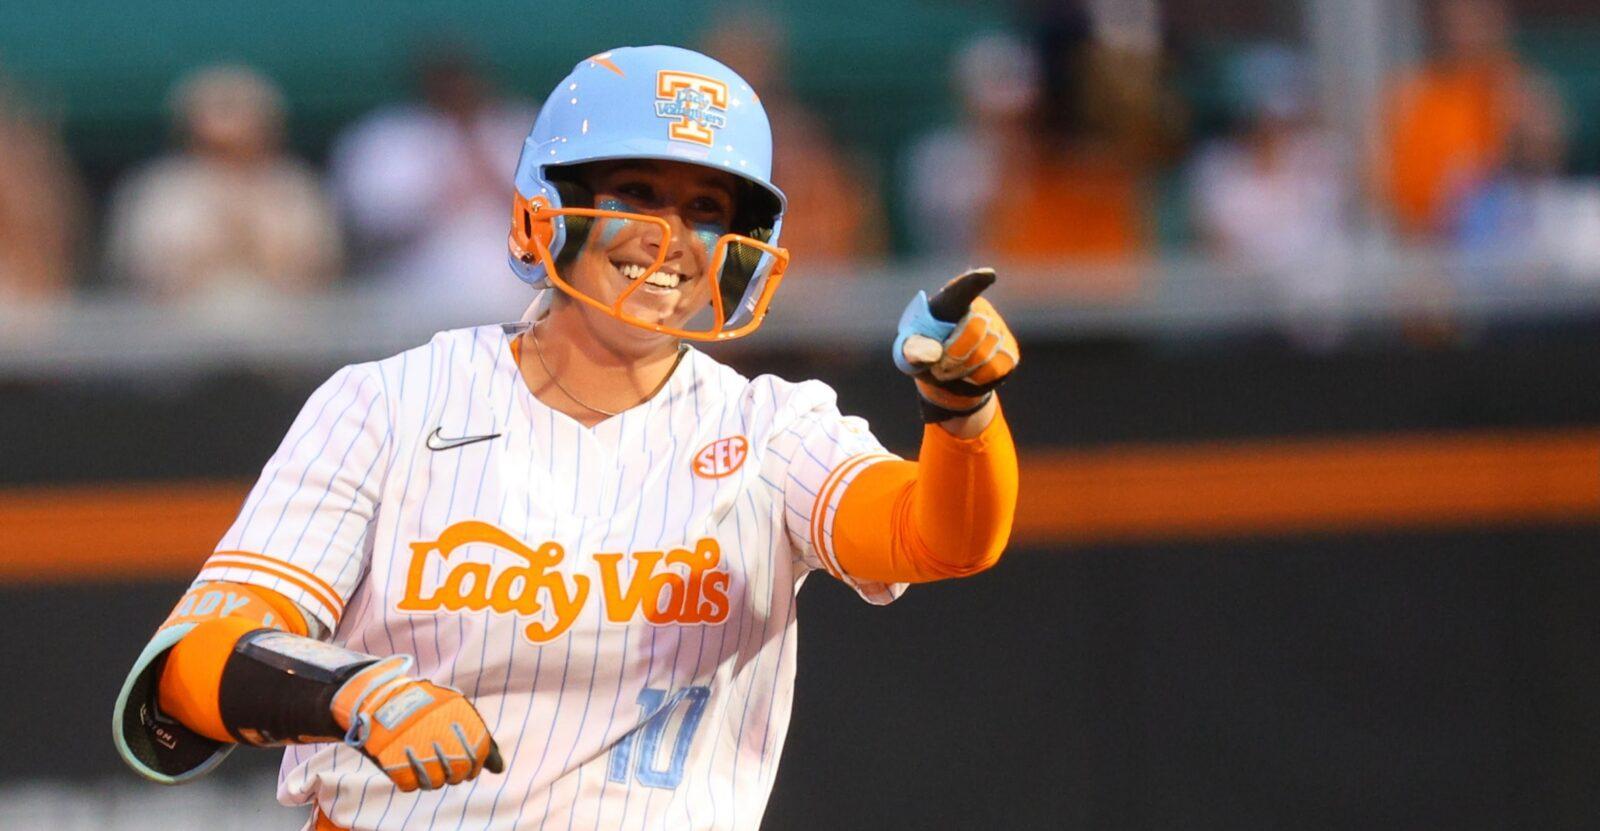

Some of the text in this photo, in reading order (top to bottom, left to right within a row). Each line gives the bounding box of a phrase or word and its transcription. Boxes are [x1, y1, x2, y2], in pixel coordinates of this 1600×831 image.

[657, 70, 727, 147] T
[696, 438, 746, 476] SEC
[179, 590, 249, 618] ADY
[397, 520, 730, 643] Lady Vols
[608, 685, 711, 790] 10
